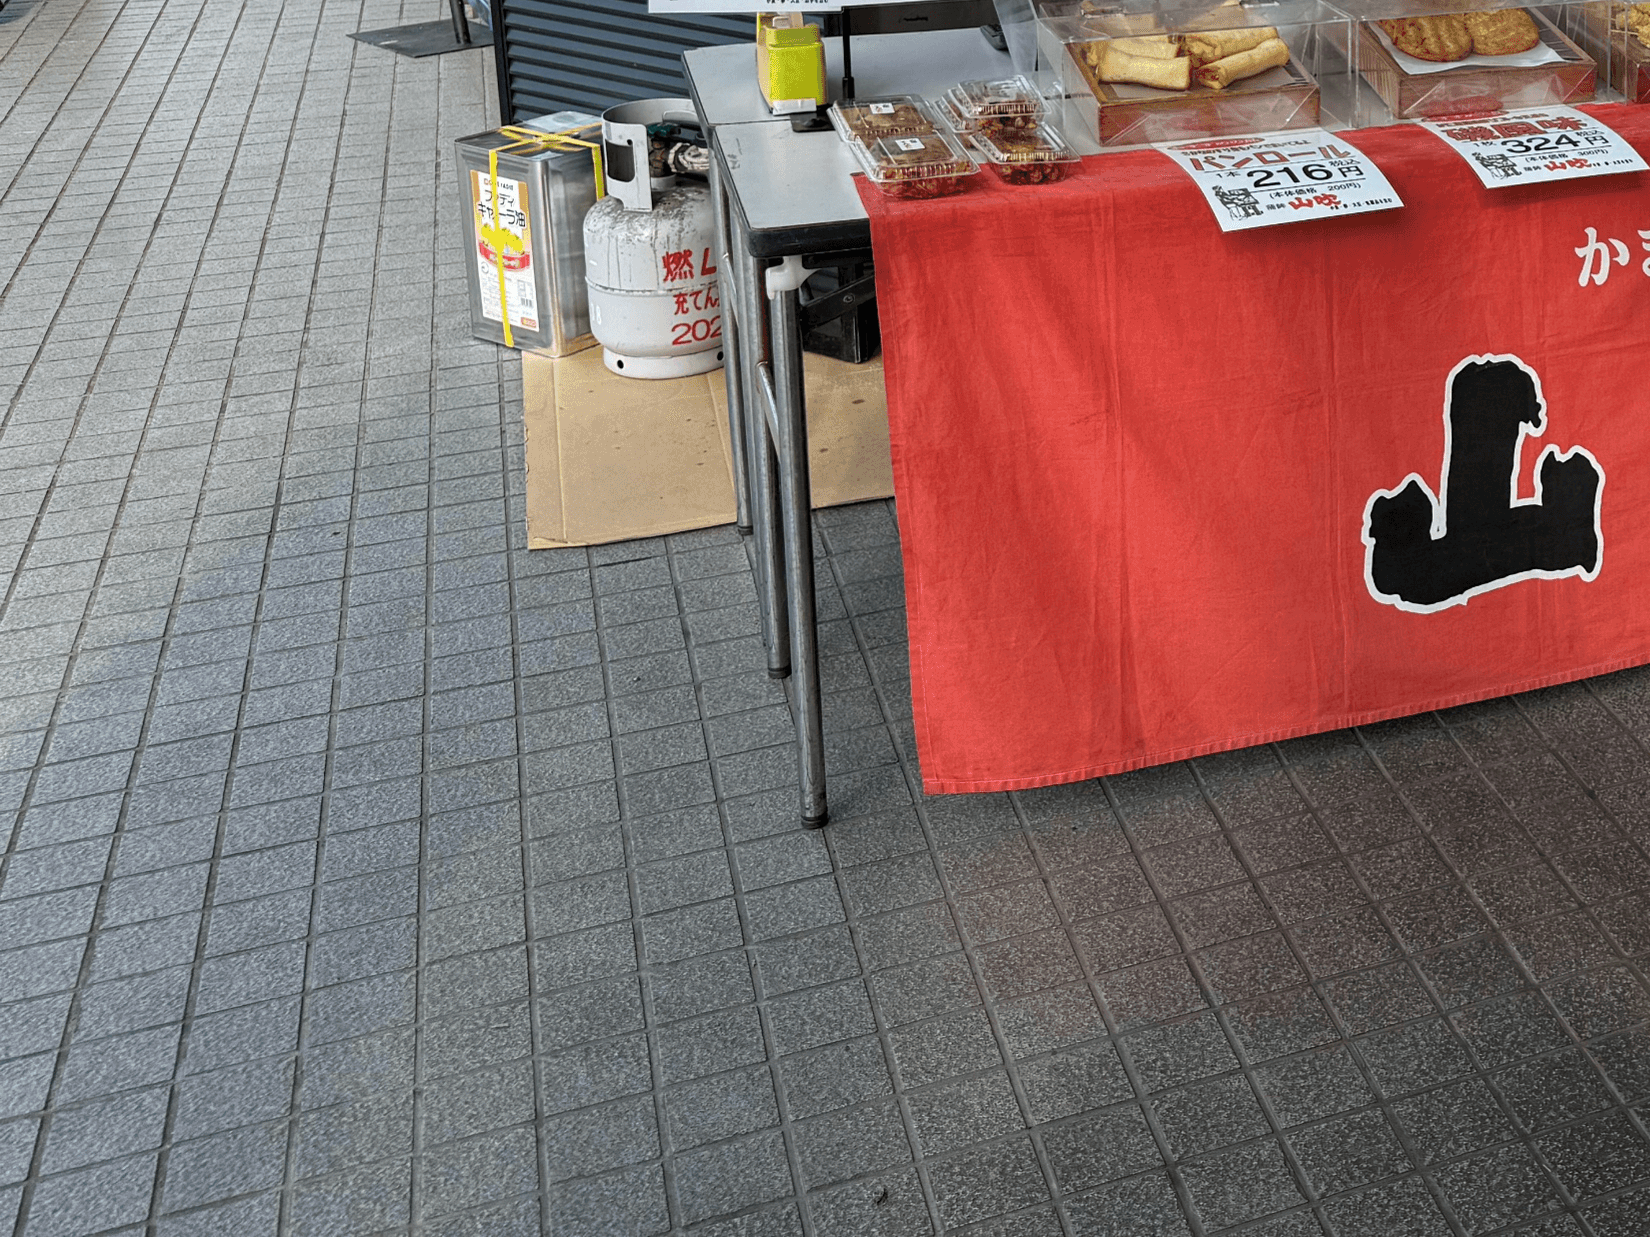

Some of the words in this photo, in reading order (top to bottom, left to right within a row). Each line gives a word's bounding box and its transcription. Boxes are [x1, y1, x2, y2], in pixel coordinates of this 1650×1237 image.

[1501, 133, 1581, 154] 324
[1586, 135, 1610, 146] 円
[1189, 144, 1352, 171] パンロール
[1246, 163, 1334, 188] 216
[1338, 166, 1365, 179] 円
[477, 200, 527, 228] キャーラ油
[1288, 192, 1343, 211] 山吹
[662, 248, 695, 282] 燃
